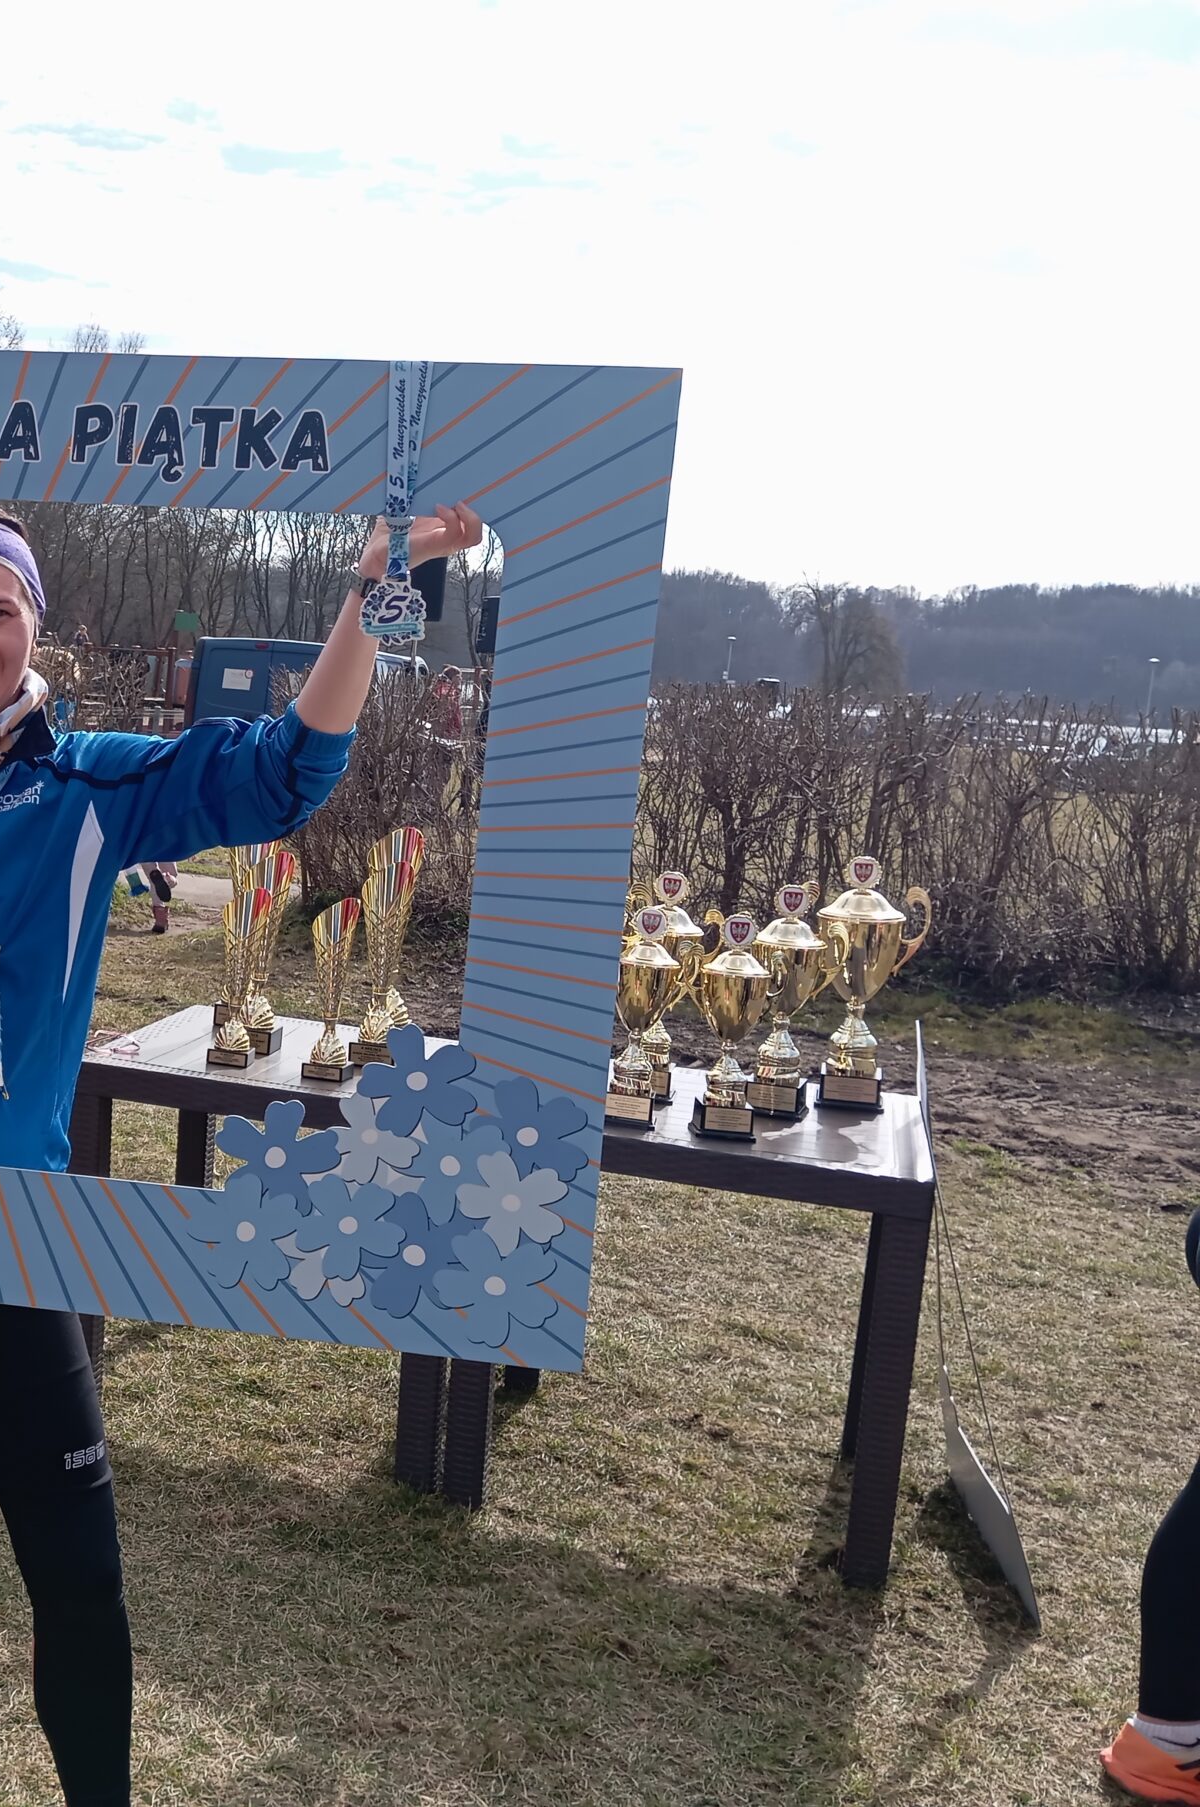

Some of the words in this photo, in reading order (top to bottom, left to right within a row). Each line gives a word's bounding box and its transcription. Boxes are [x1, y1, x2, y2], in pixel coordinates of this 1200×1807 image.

[69, 401, 331, 484] PIĄTKA
[393, 378, 408, 460] Nauczycielska
[390, 474, 405, 490] 5
[378, 595, 409, 624] 5
